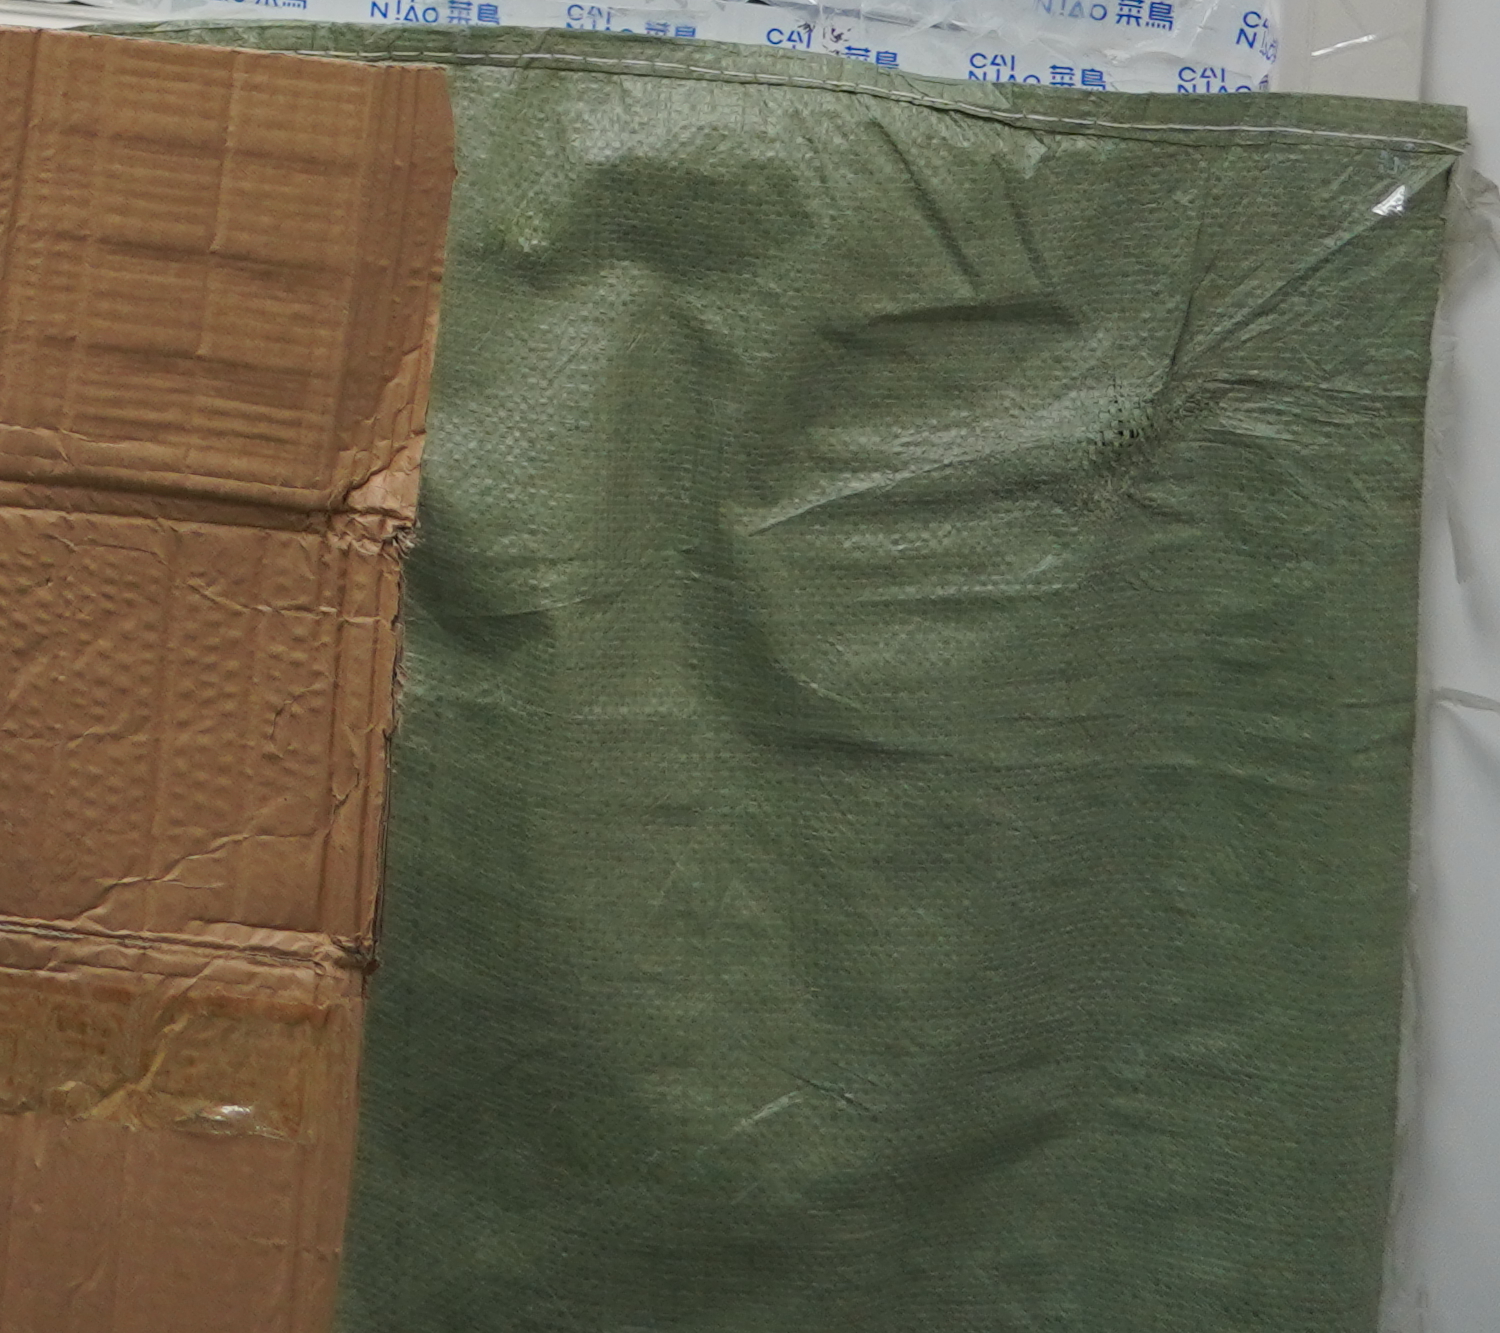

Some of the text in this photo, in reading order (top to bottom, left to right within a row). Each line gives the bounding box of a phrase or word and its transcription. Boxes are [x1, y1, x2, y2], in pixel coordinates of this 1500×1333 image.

[370, 0, 439, 25] NIAO
[446, 0, 500, 26] 菜鳥
[566, 3, 613, 25] CAI
[765, 28, 812, 50] CAI
[969, 52, 1016, 71] CAI
[1177, 66, 1226, 84] CAI
